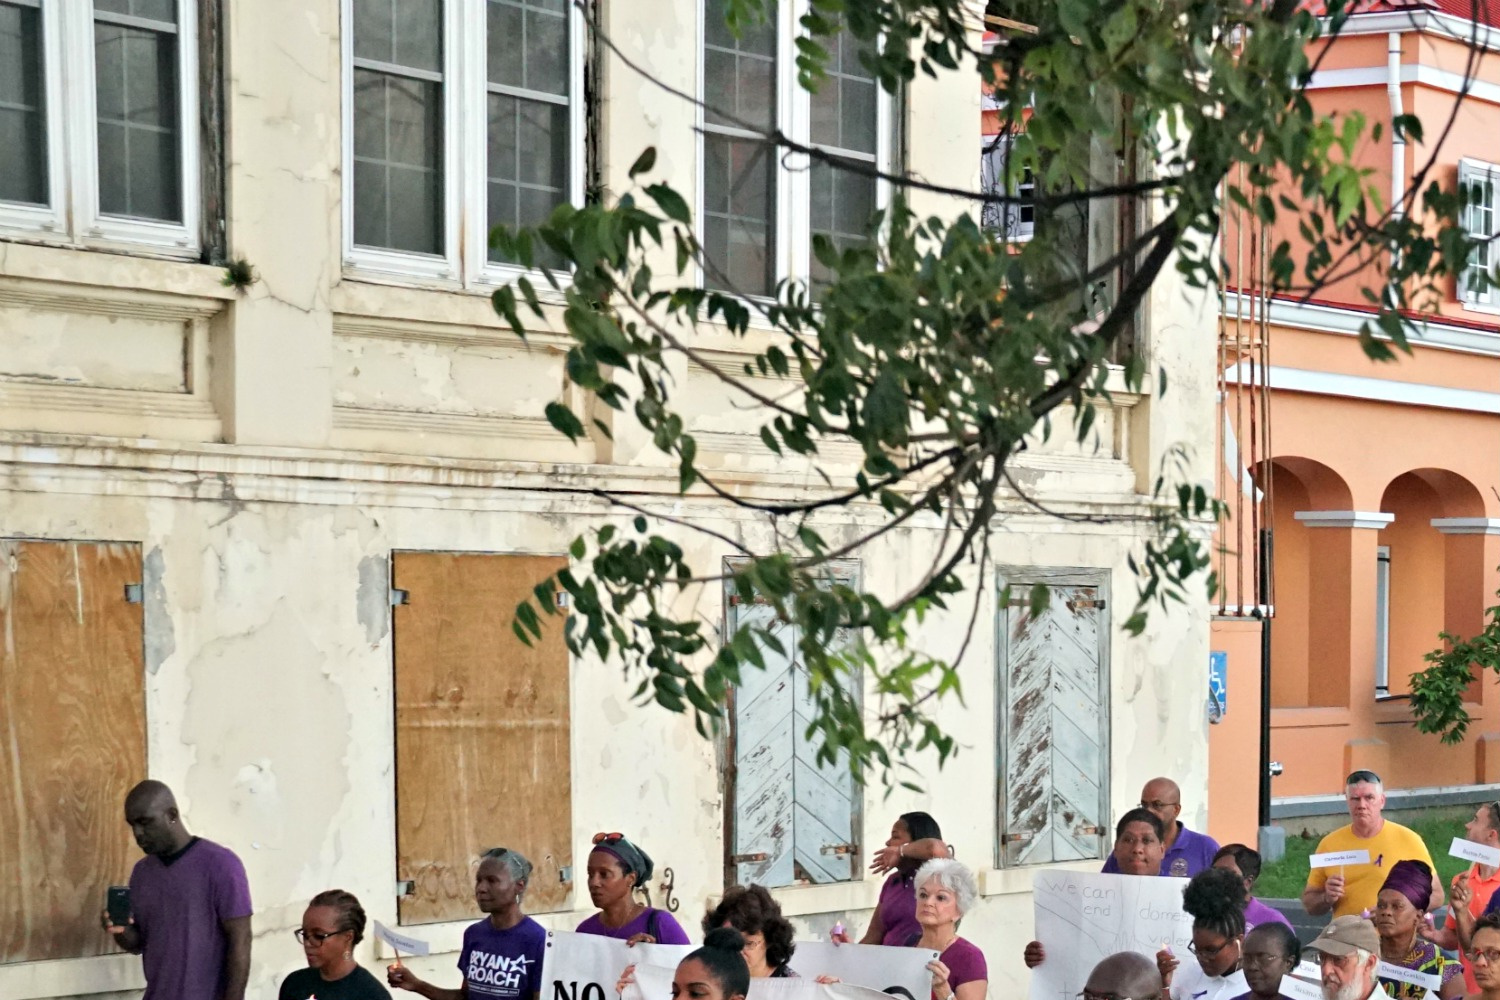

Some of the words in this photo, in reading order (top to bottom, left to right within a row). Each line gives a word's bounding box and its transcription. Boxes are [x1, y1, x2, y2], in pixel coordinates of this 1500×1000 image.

[1050, 881, 1077, 895] We
[1083, 886, 1116, 899] can
[1084, 903, 1112, 917] end
[468, 965, 520, 988] ROACH
